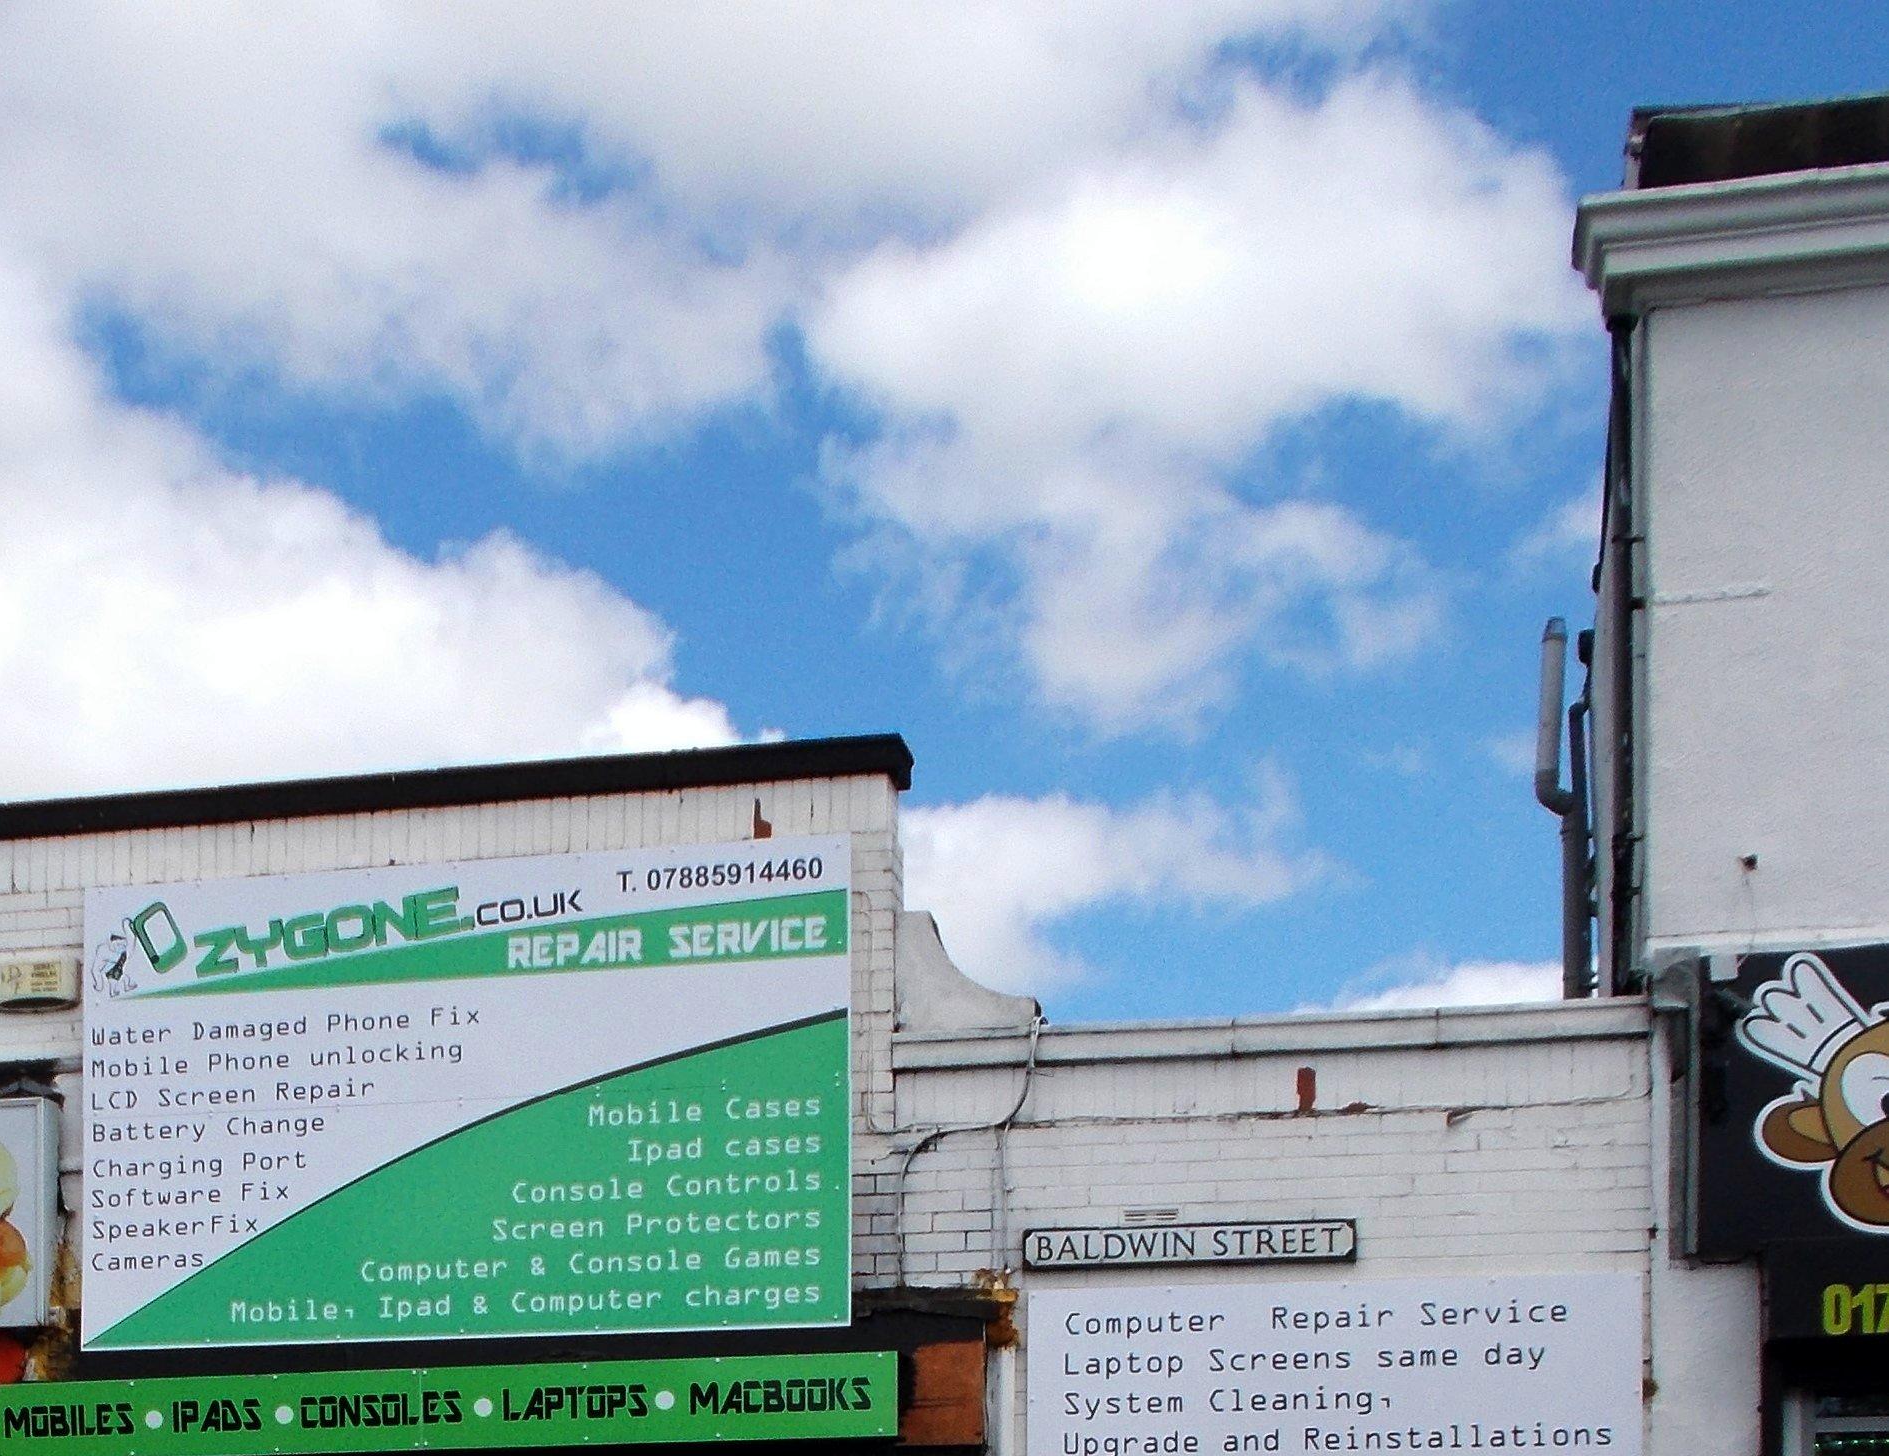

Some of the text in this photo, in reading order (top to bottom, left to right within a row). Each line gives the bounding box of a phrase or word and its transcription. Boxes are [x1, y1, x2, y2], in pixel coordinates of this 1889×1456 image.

[617, 856, 823, 894] T. 07885914460
[508, 915, 827, 969] REPAIR SERVICE
[92, 1006, 480, 1046] Water Damaged Phone Fix
[92, 1041, 463, 1078] Mobile Phone unlocking
[92, 1079, 374, 1111] LCD Screen Repair
[92, 1116, 325, 1143] Battery Change
[589, 1097, 821, 1128] Mobile Cases
[92, 1150, 307, 1179] Charging Port
[627, 1138, 702, 1164] Ipad
[92, 1181, 289, 1209] Software Fix
[513, 1169, 821, 1204] Console Controls
[493, 1208, 821, 1241] Screen Protectors
[1035, 1227, 1343, 1261] BALDWIN STREET
[92, 1252, 204, 1272] Cameras
[361, 1246, 821, 1286] Computer & Console Games
[379, 1295, 451, 1319] Ipad
[473, 1294, 487, 1315] &
[512, 1288, 662, 1314] Computer
[686, 1282, 821, 1308] charges
[1065, 1300, 1567, 1339] Computer Repair Service
[1064, 1343, 1545, 1380] Laptop Screens same day
[4, 1377, 872, 1439] MOBILES IPADS CONSOLES LAPTOPS MACBOOKS
[1064, 1392, 1183, 1420] System
[1223, 1429, 1279, 1452] and
[1304, 1422, 1612, 1450] Reinstallations
